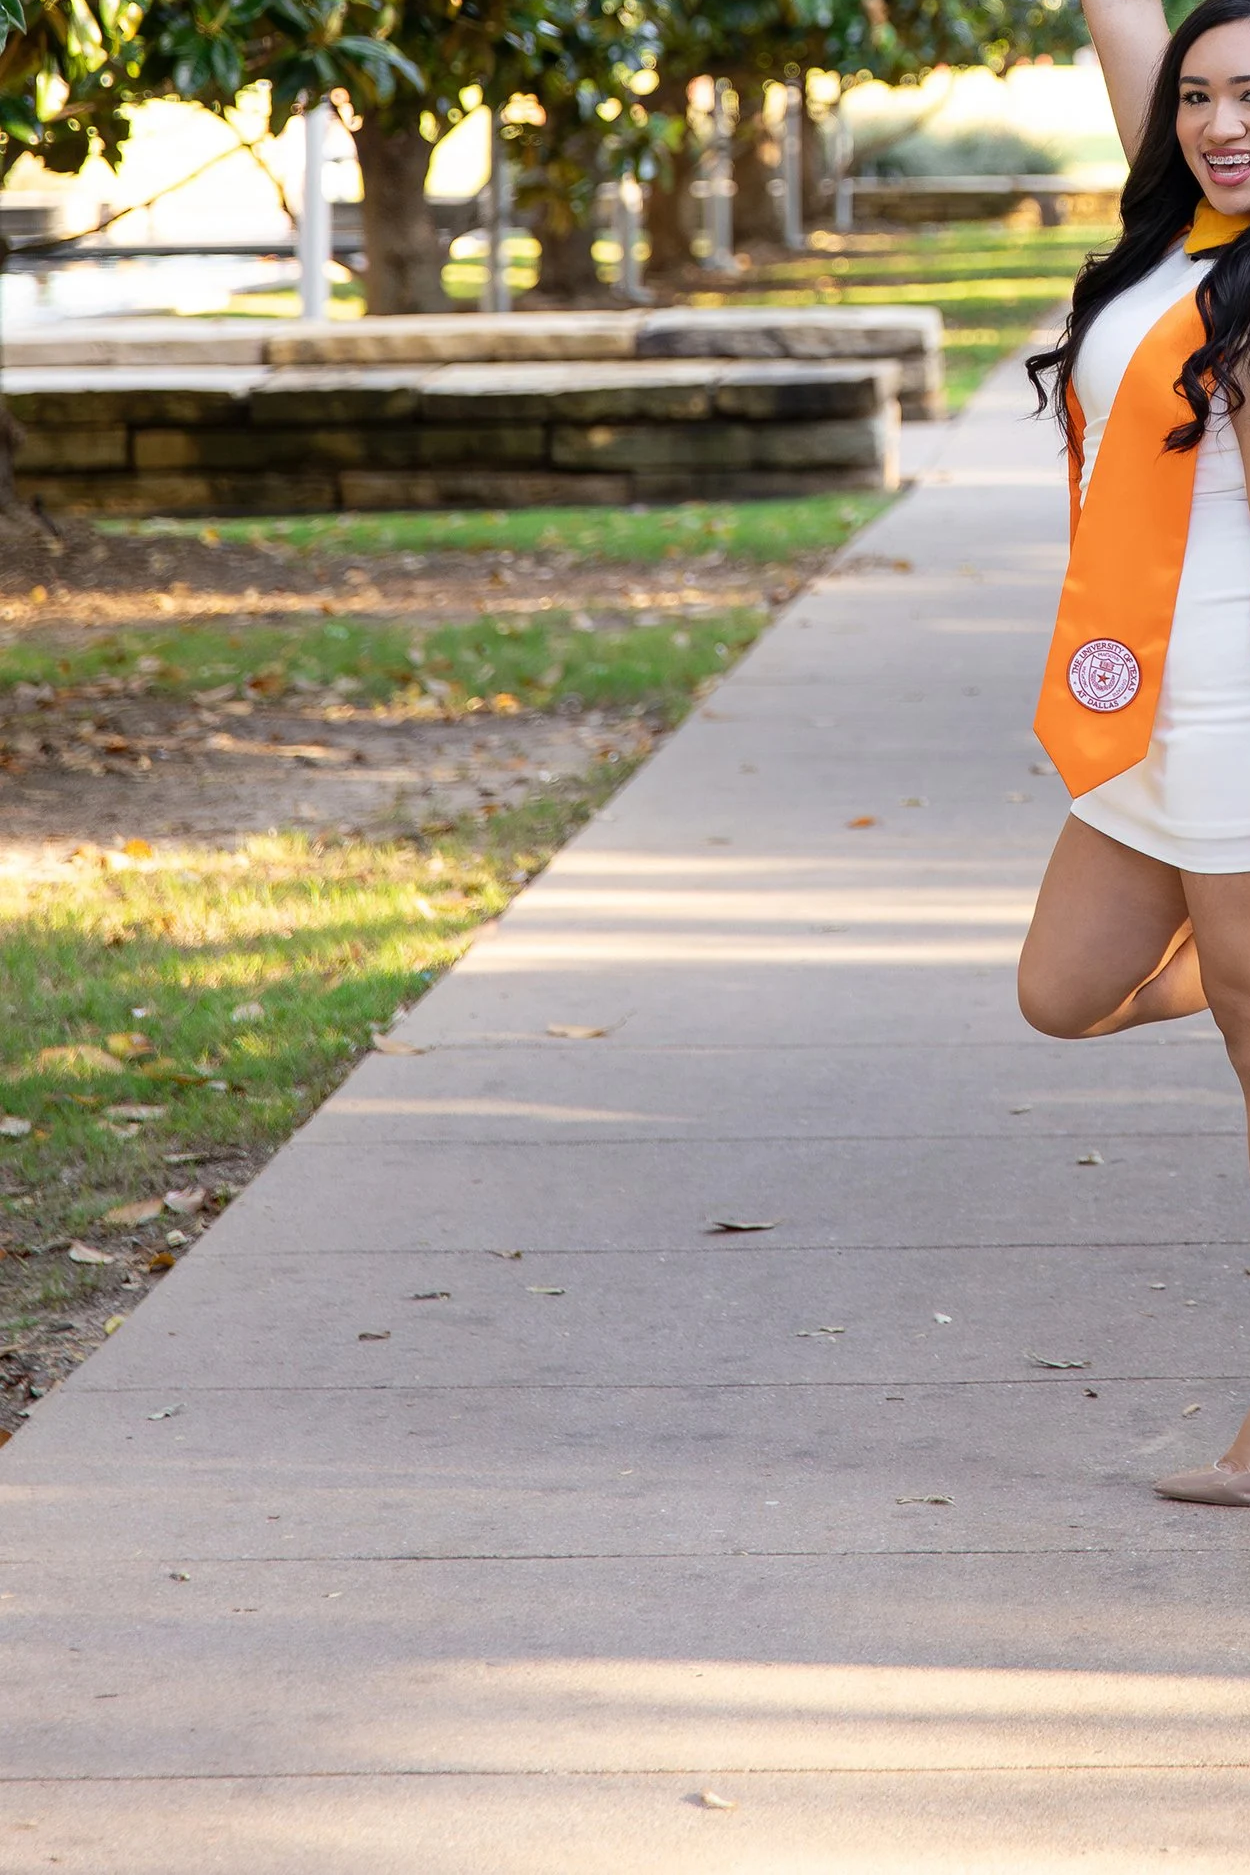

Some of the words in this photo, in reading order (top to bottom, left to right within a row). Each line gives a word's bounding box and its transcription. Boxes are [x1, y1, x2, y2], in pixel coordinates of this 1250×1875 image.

[1072, 659, 1081, 675] THE
[1079, 642, 1124, 659] UNIVERSITY
[1123, 653, 1133, 664] OF
[1128, 665, 1137, 692] TEXAS
[1076, 690, 1087, 699] AT
[1087, 698, 1119, 709] DALLAS
